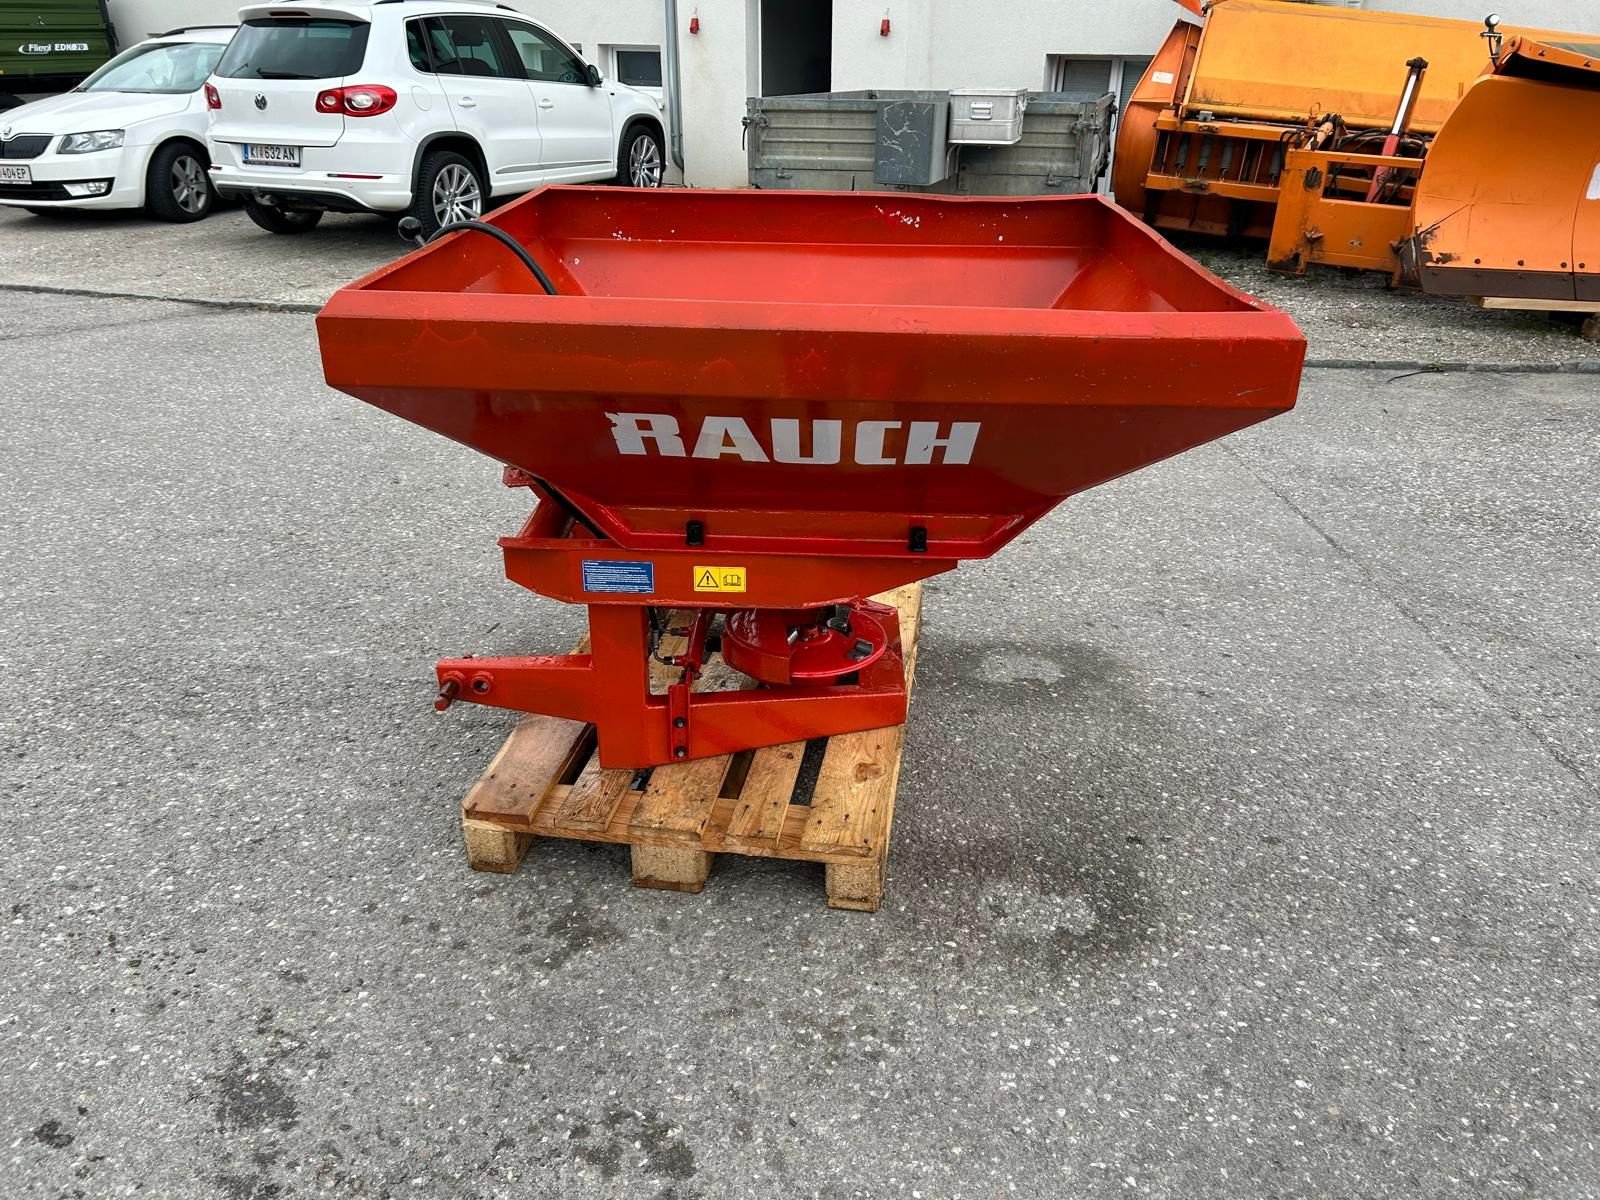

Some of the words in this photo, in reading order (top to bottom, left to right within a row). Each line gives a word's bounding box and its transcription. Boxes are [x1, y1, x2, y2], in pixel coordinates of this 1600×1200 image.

[250, 145, 258, 159] KI
[264, 146, 281, 160] 632
[283, 147, 295, 161] AN
[604, 411, 982, 466] RAUCH
